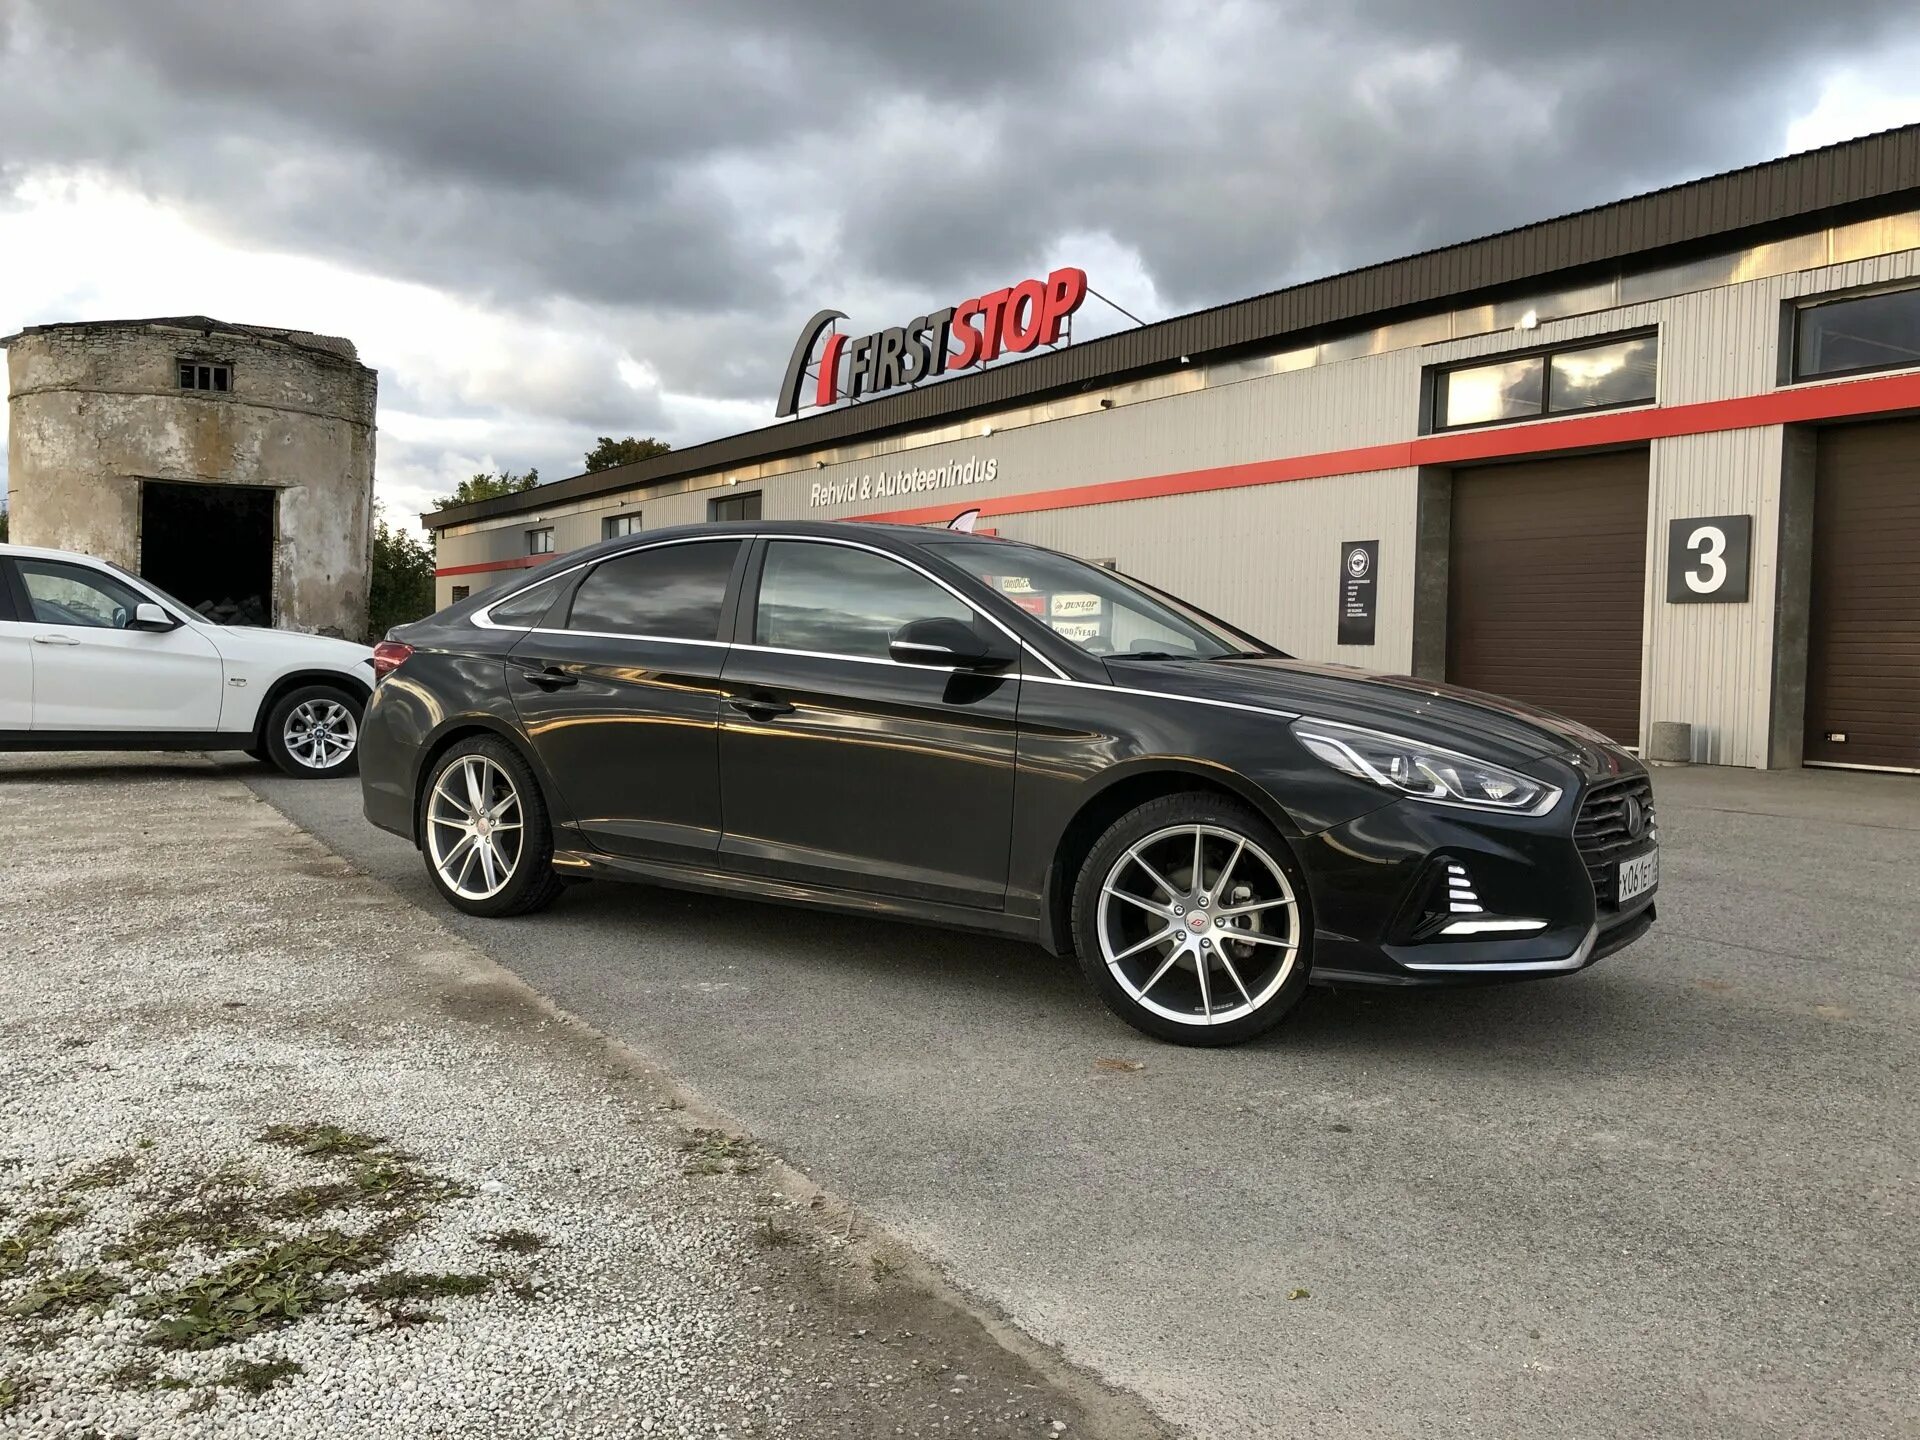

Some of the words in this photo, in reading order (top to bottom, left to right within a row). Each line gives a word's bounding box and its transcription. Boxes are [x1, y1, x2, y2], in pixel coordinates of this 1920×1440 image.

[810, 477, 860, 507] Rehvid
[860, 475, 872, 500] &
[875, 456, 998, 498] Autoteenindus
[1685, 526, 1727, 594] 3
[1064, 601, 1098, 610] DUNLOP
